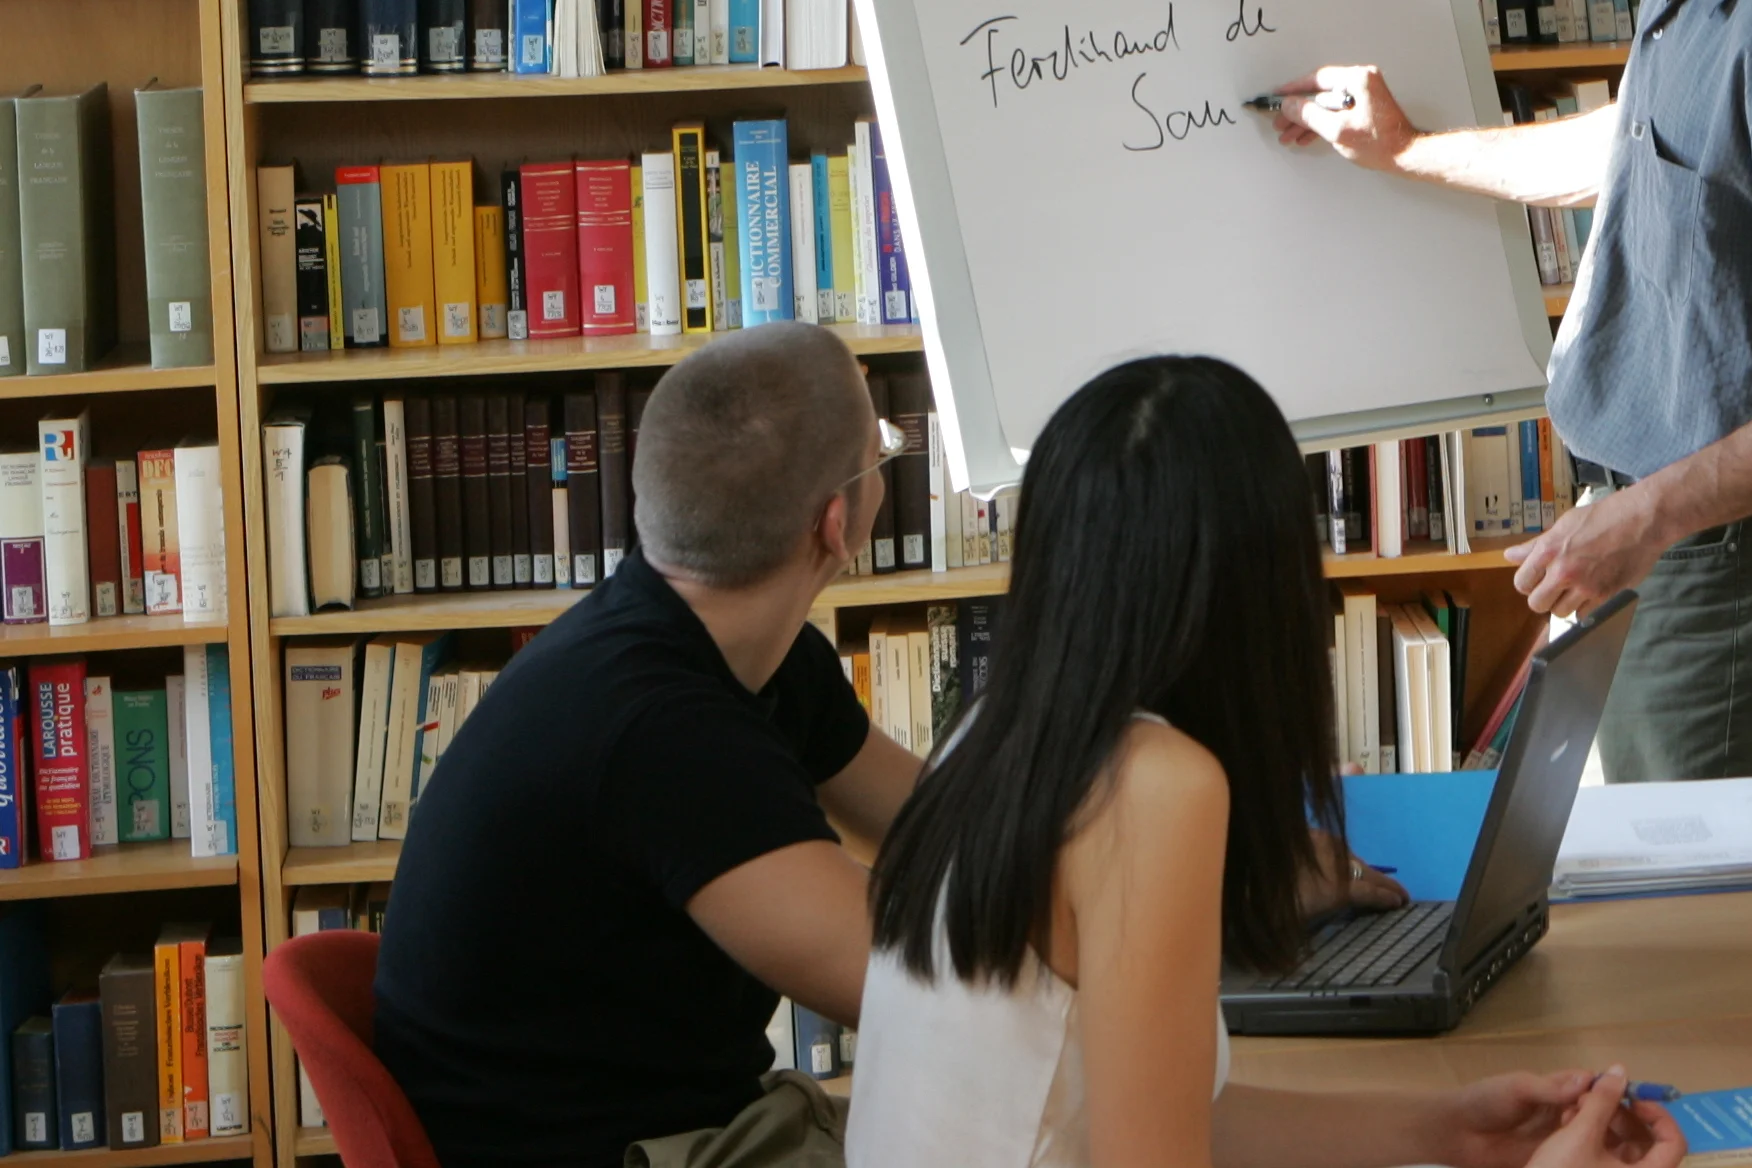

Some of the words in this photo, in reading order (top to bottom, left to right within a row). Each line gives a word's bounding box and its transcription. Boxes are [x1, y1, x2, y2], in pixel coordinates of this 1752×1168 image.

[746, 161, 766, 288] DICTIONNAIRE
[765, 165, 783, 288] COMMERCIAL
[142, 458, 174, 479] DFC
[40, 683, 57, 758] LAROUSSE
[57, 682, 78, 757] pratique
[125, 728, 156, 807] PONS
